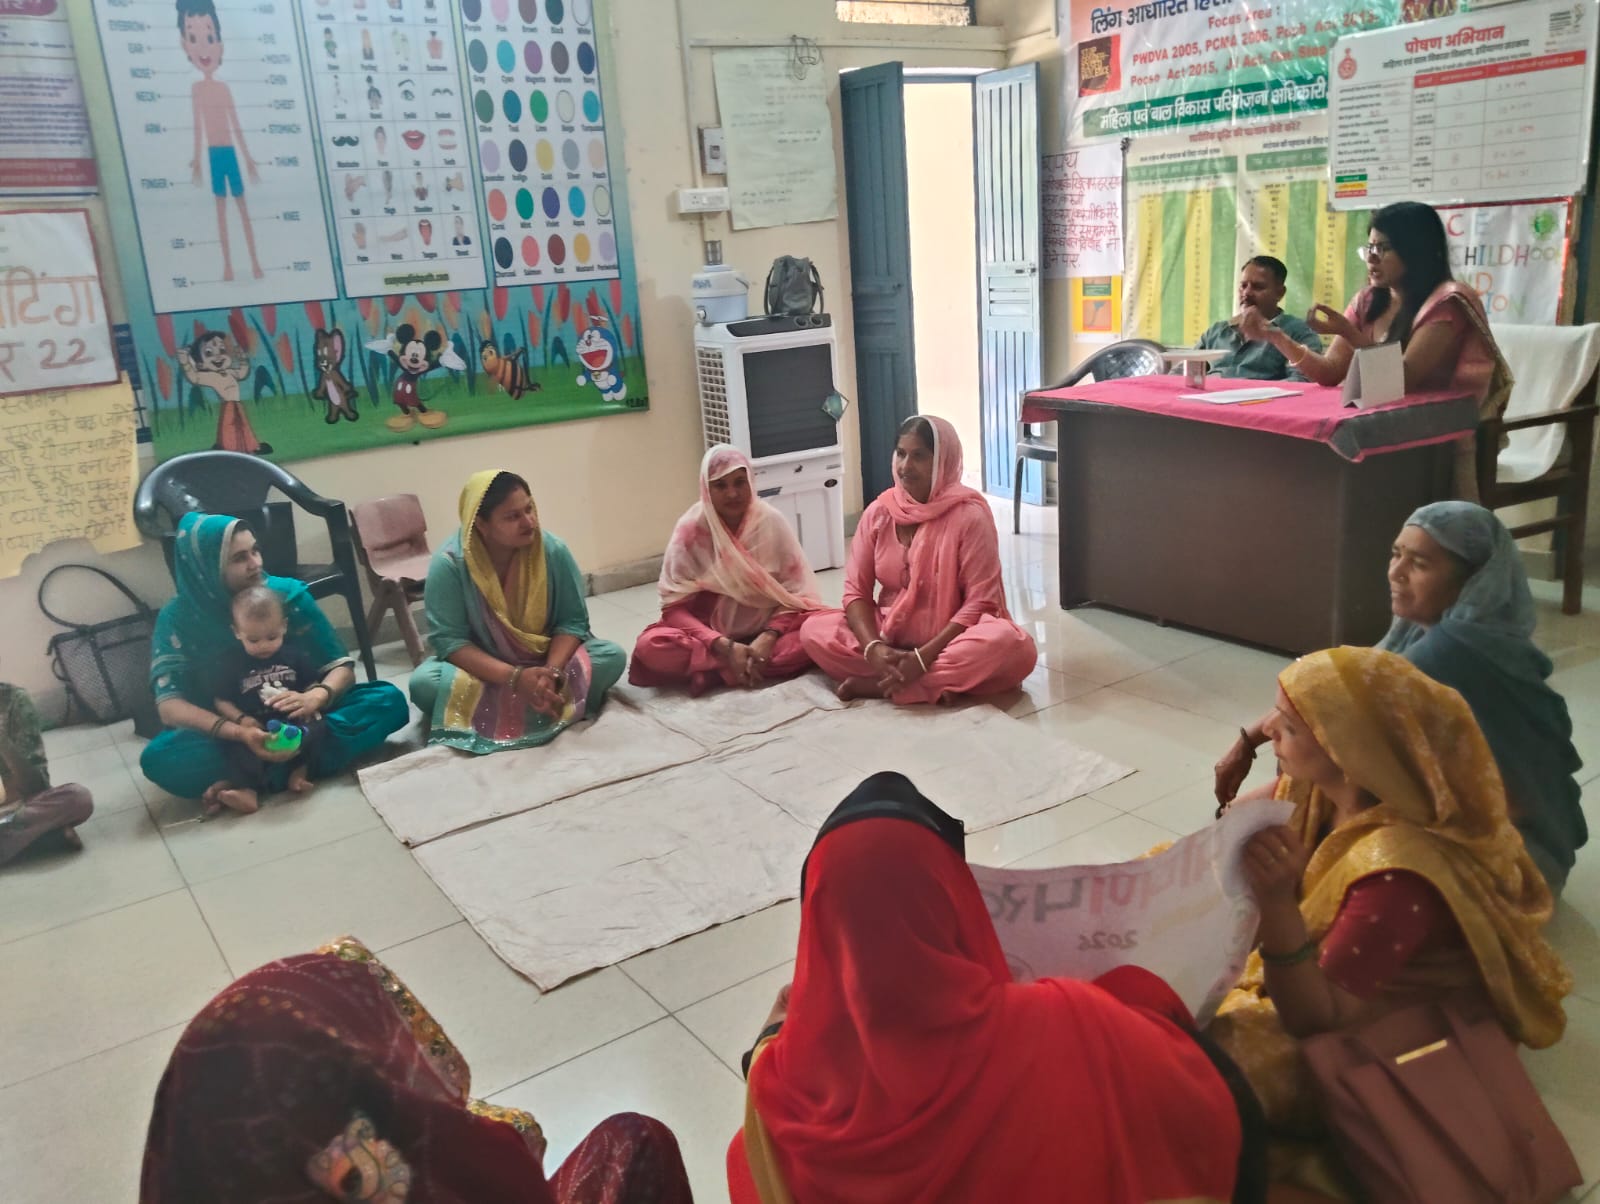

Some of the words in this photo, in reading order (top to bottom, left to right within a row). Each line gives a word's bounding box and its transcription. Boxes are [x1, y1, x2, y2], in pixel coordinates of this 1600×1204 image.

[1091, 6, 1122, 34] लिंग
[1208, 14, 1241, 29] Focus
[1405, 36, 1442, 54] पोषण
[1446, 25, 1506, 48] अभियान
[1132, 49, 1168, 66] PWDVA
[1171, 43, 1202, 60] 2005,
[1167, 67, 1186, 81] Act
[1101, 107, 1131, 129] महिला
[1151, 104, 1172, 121] बाल
[1174, 96, 1211, 118] विकास
[1213, 88, 1269, 112] परियोजना
[38, 338, 95, 370] 22
